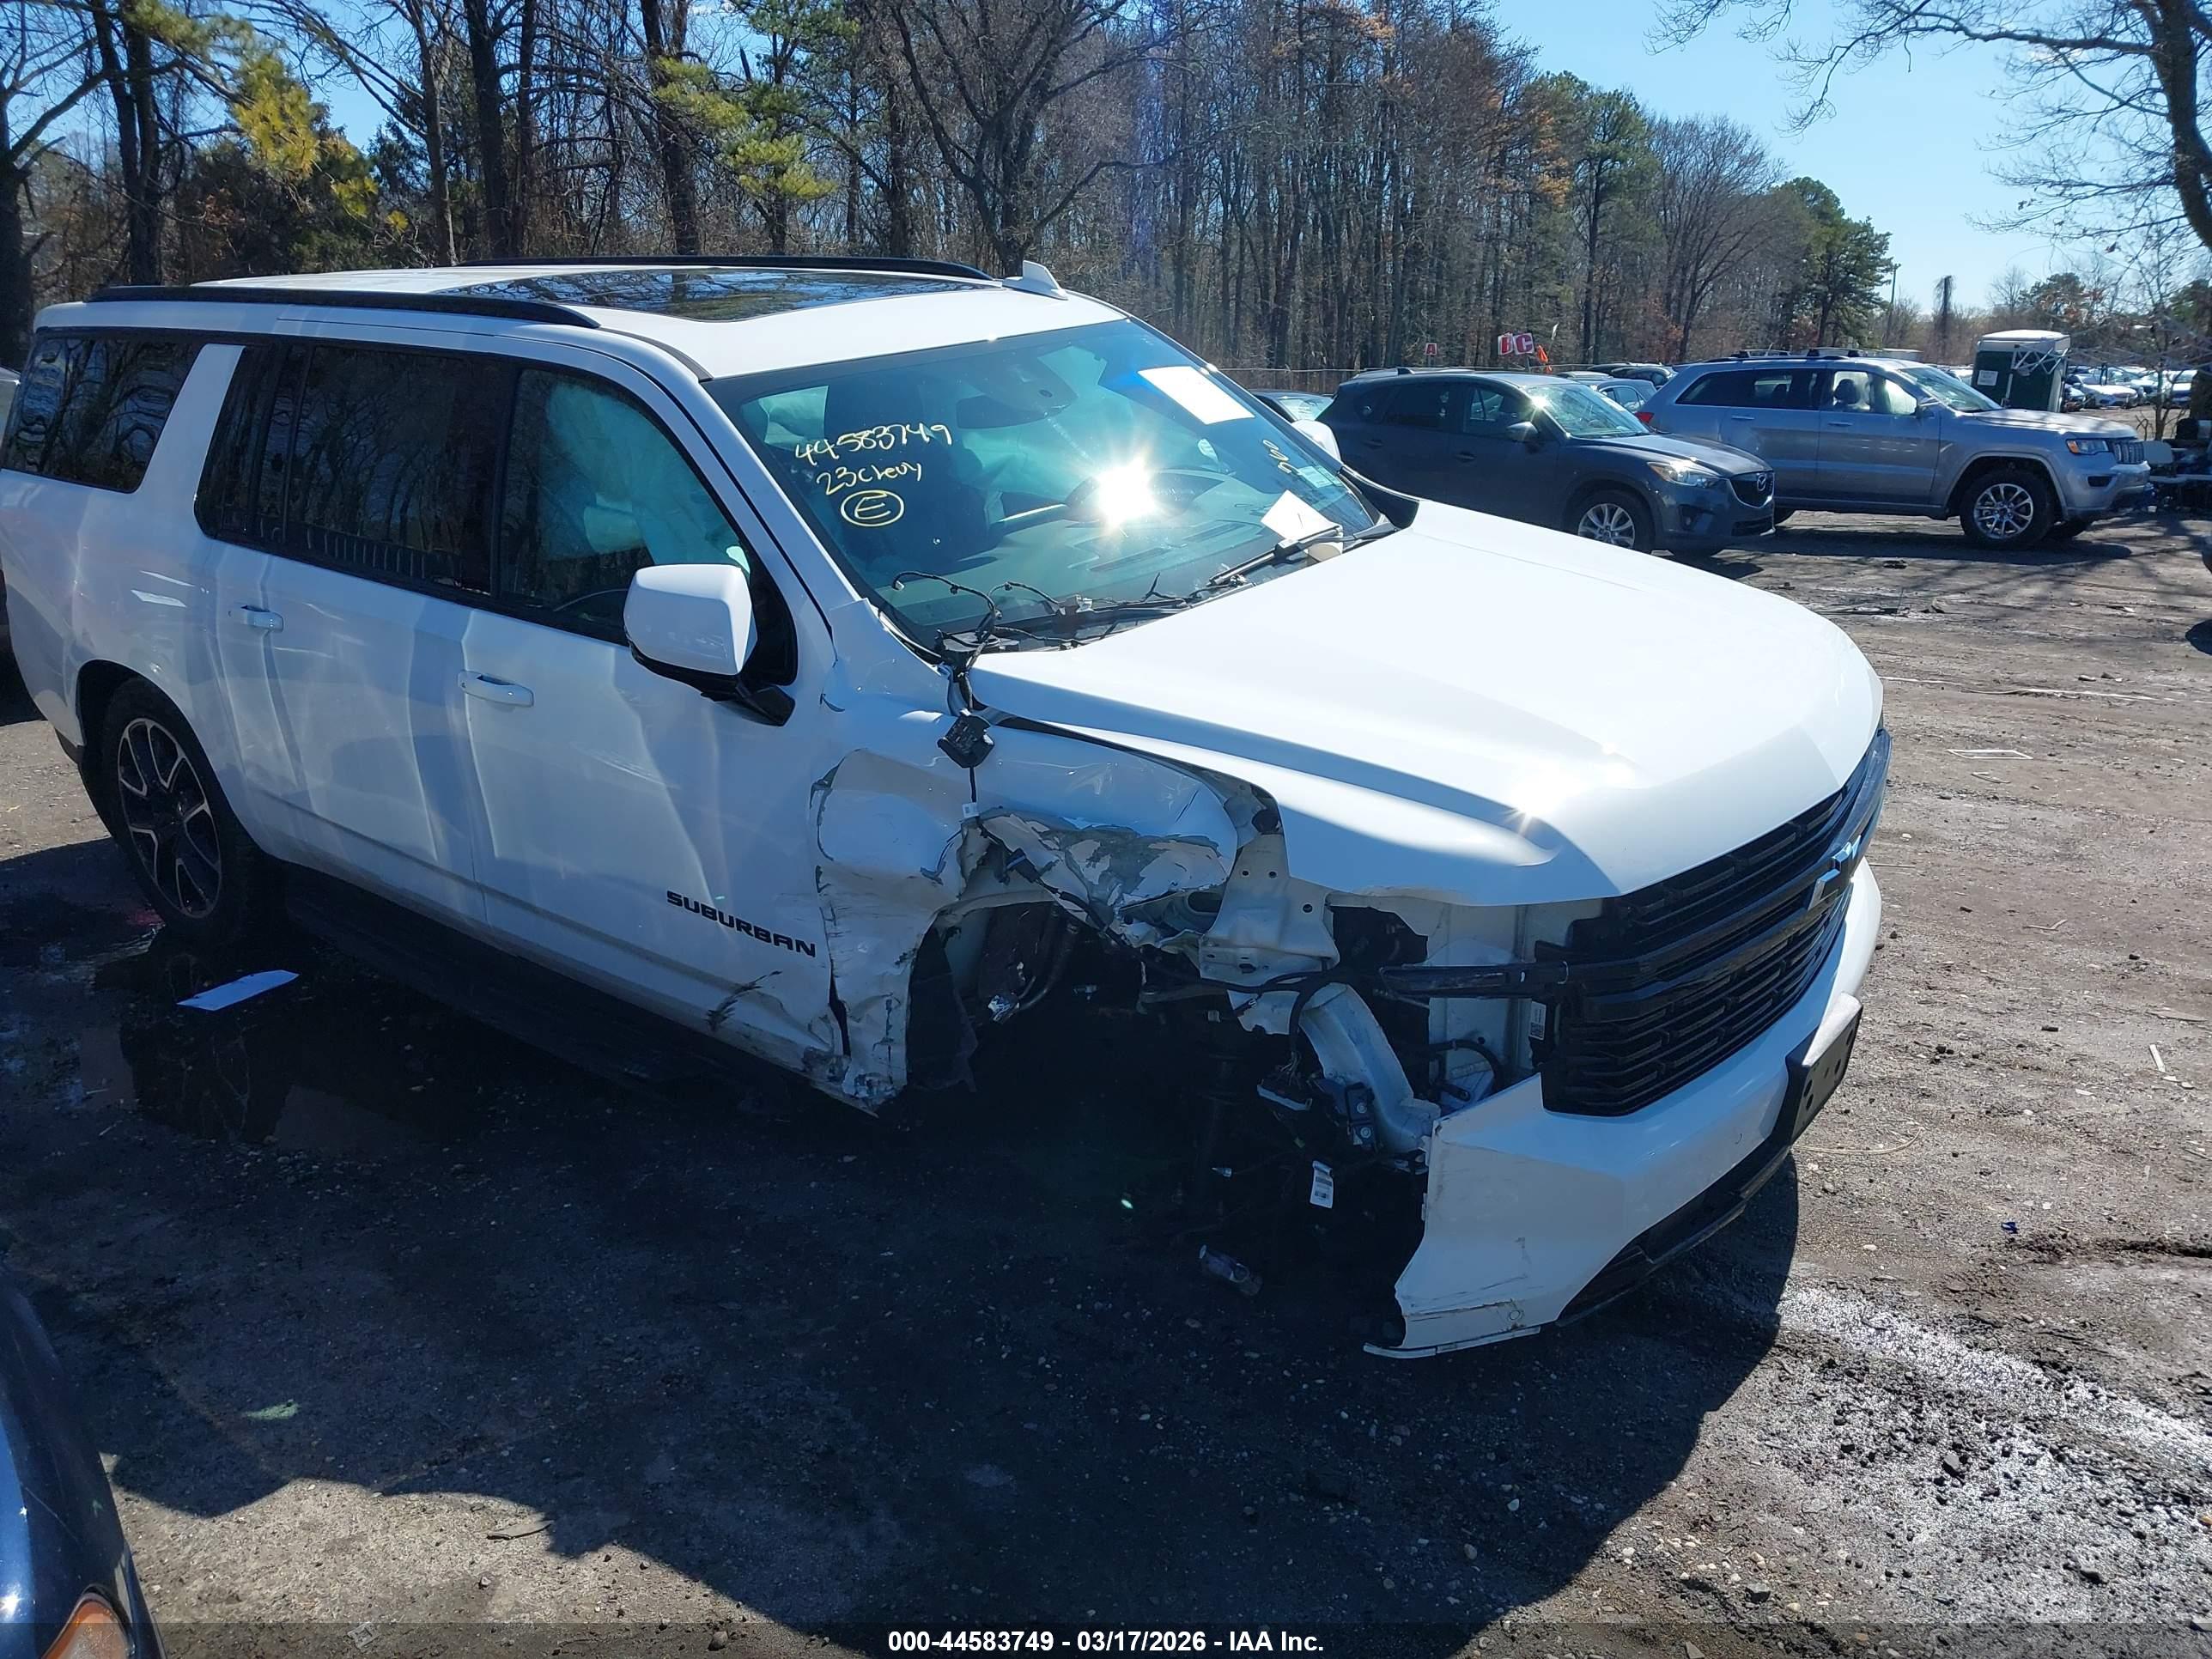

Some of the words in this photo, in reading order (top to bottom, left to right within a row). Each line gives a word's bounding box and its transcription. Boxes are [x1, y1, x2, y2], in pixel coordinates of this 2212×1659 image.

[1425, 343, 1436, 355] A
[1516, 334, 1534, 354] C
[795, 422, 952, 465] 44583749
[666, 890, 816, 957] SUBURBAN
